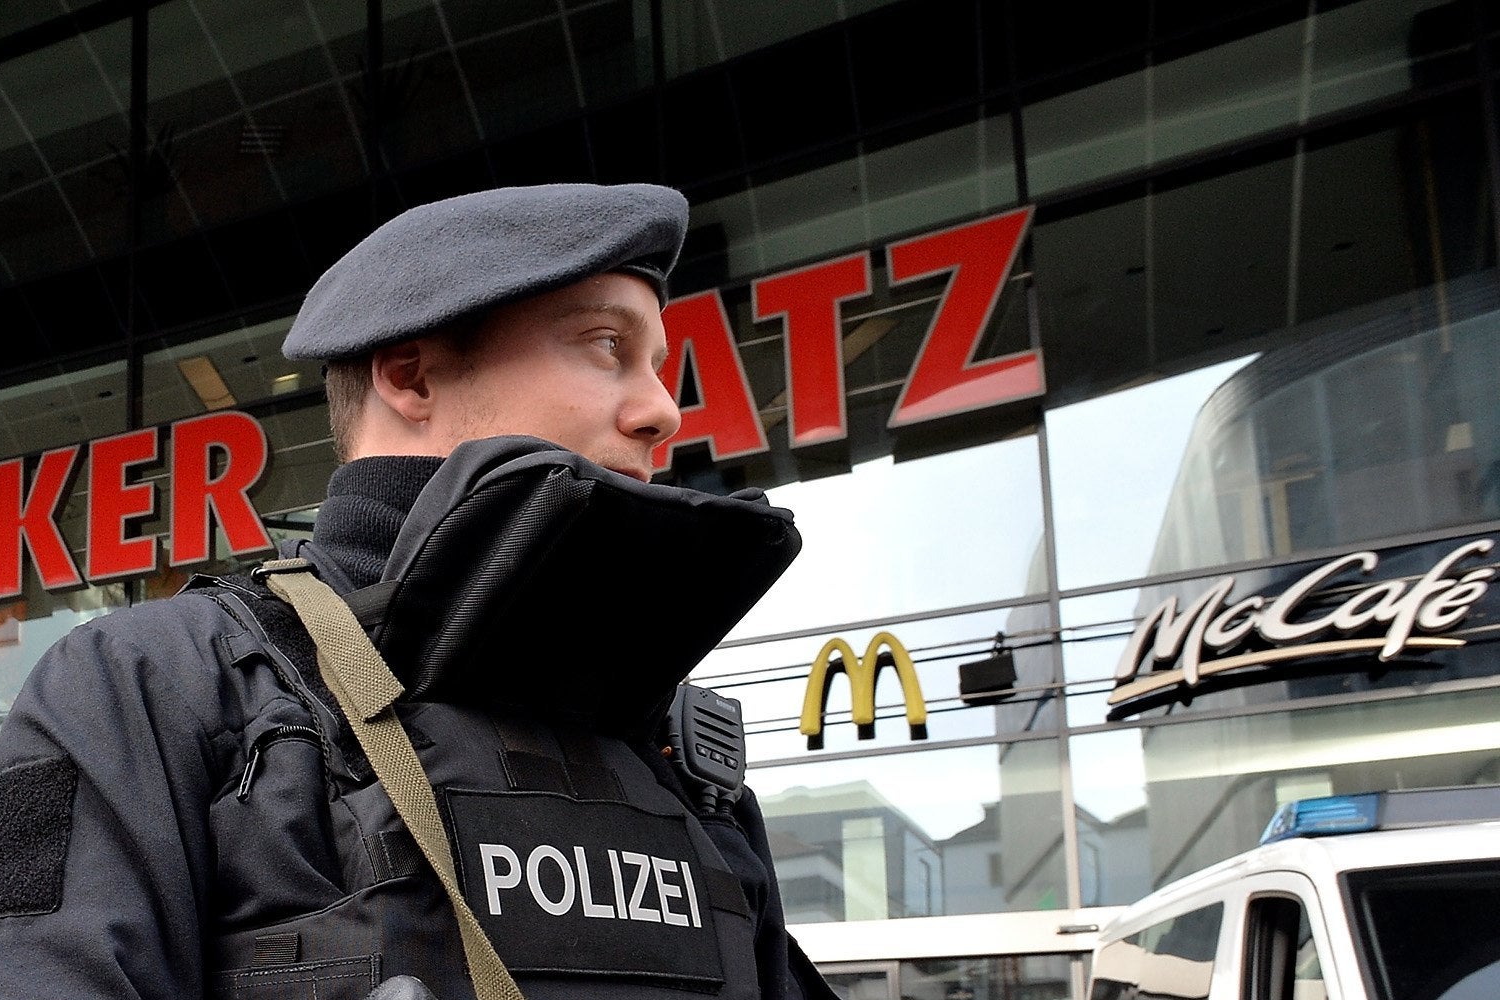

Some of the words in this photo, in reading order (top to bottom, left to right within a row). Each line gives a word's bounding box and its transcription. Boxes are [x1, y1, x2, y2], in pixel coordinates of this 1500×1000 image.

[651, 205, 1046, 473] ATZ
[1114, 538, 1496, 686] McCafé
[479, 843, 702, 928] POLIZEI
